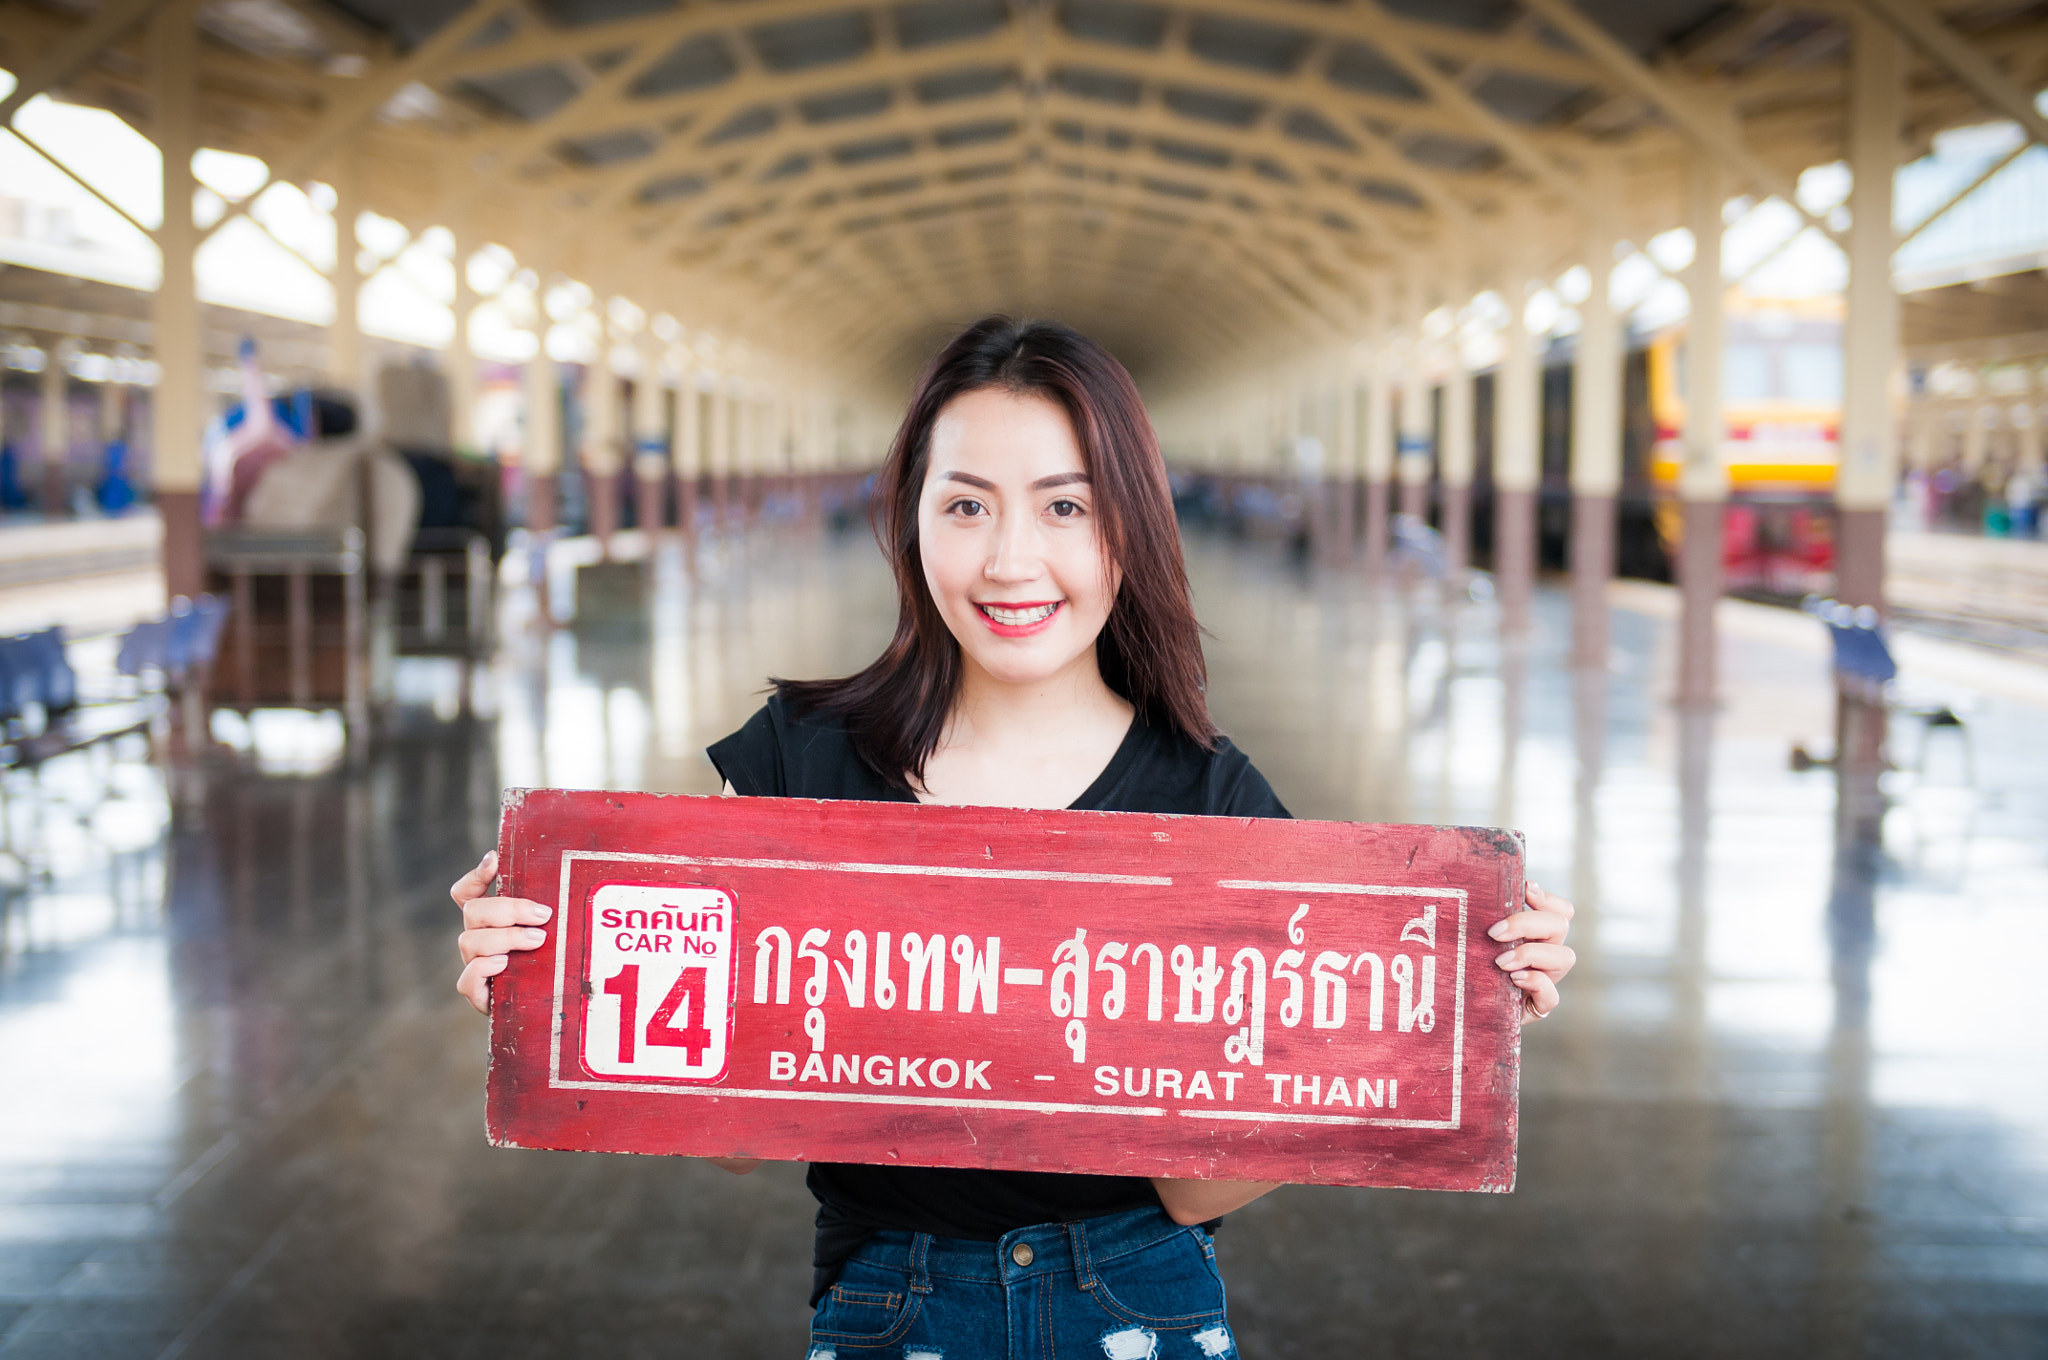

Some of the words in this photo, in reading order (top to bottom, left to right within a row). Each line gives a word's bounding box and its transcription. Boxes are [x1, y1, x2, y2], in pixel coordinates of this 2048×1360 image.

[600, 897, 724, 932] รถคันที่
[614, 932, 671, 953] CAR
[604, 963, 712, 1067] 14
[769, 1051, 992, 1090] BANGKOK
[1093, 1065, 1244, 1101] SURAT
[1265, 1073, 1398, 1109] THANI
